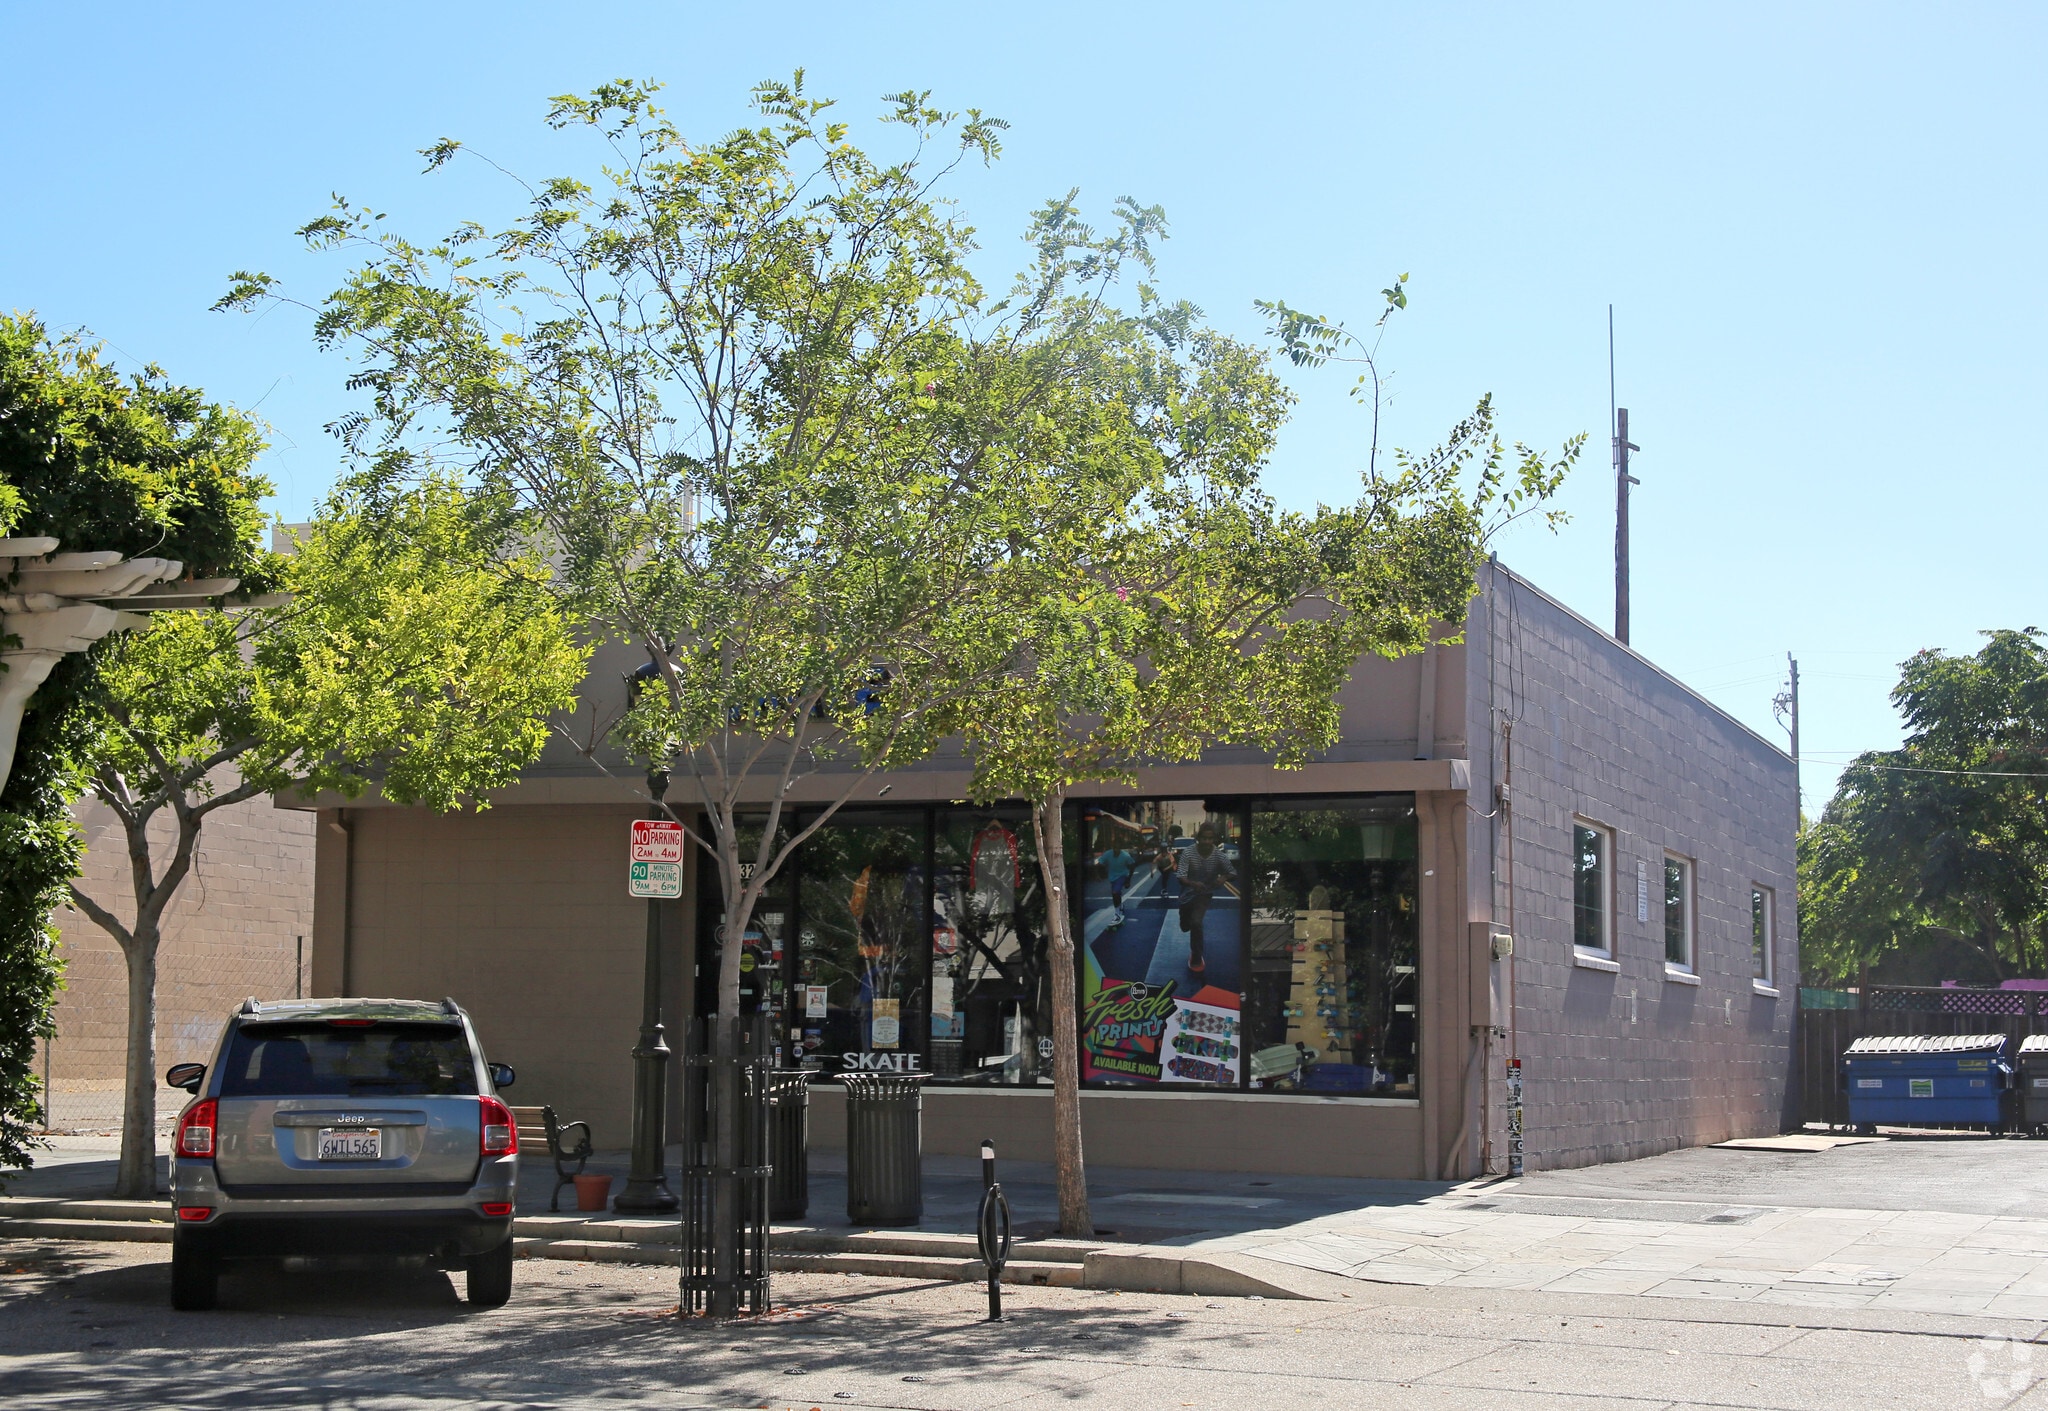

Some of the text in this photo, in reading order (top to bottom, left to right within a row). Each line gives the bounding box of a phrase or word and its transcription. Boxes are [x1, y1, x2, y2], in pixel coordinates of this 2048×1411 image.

[633, 829, 680, 846] NO PARKING
[637, 847, 653, 858] 2AM
[661, 848, 677, 859] 4AM
[632, 864, 674, 877] 90 MINUTE
[649, 872, 677, 882] PARKING
[635, 880, 650, 890] 9AM
[660, 881, 677, 891] 6PM
[1083, 980, 1174, 1028] Fresh
[1098, 1014, 1163, 1040] PRINTS
[842, 1052, 921, 1071] SKATE
[1094, 1056, 1160, 1076] AVAILABLE NOW
[337, 1114, 364, 1124] Jeep
[323, 1139, 376, 1154] 6WIL565
